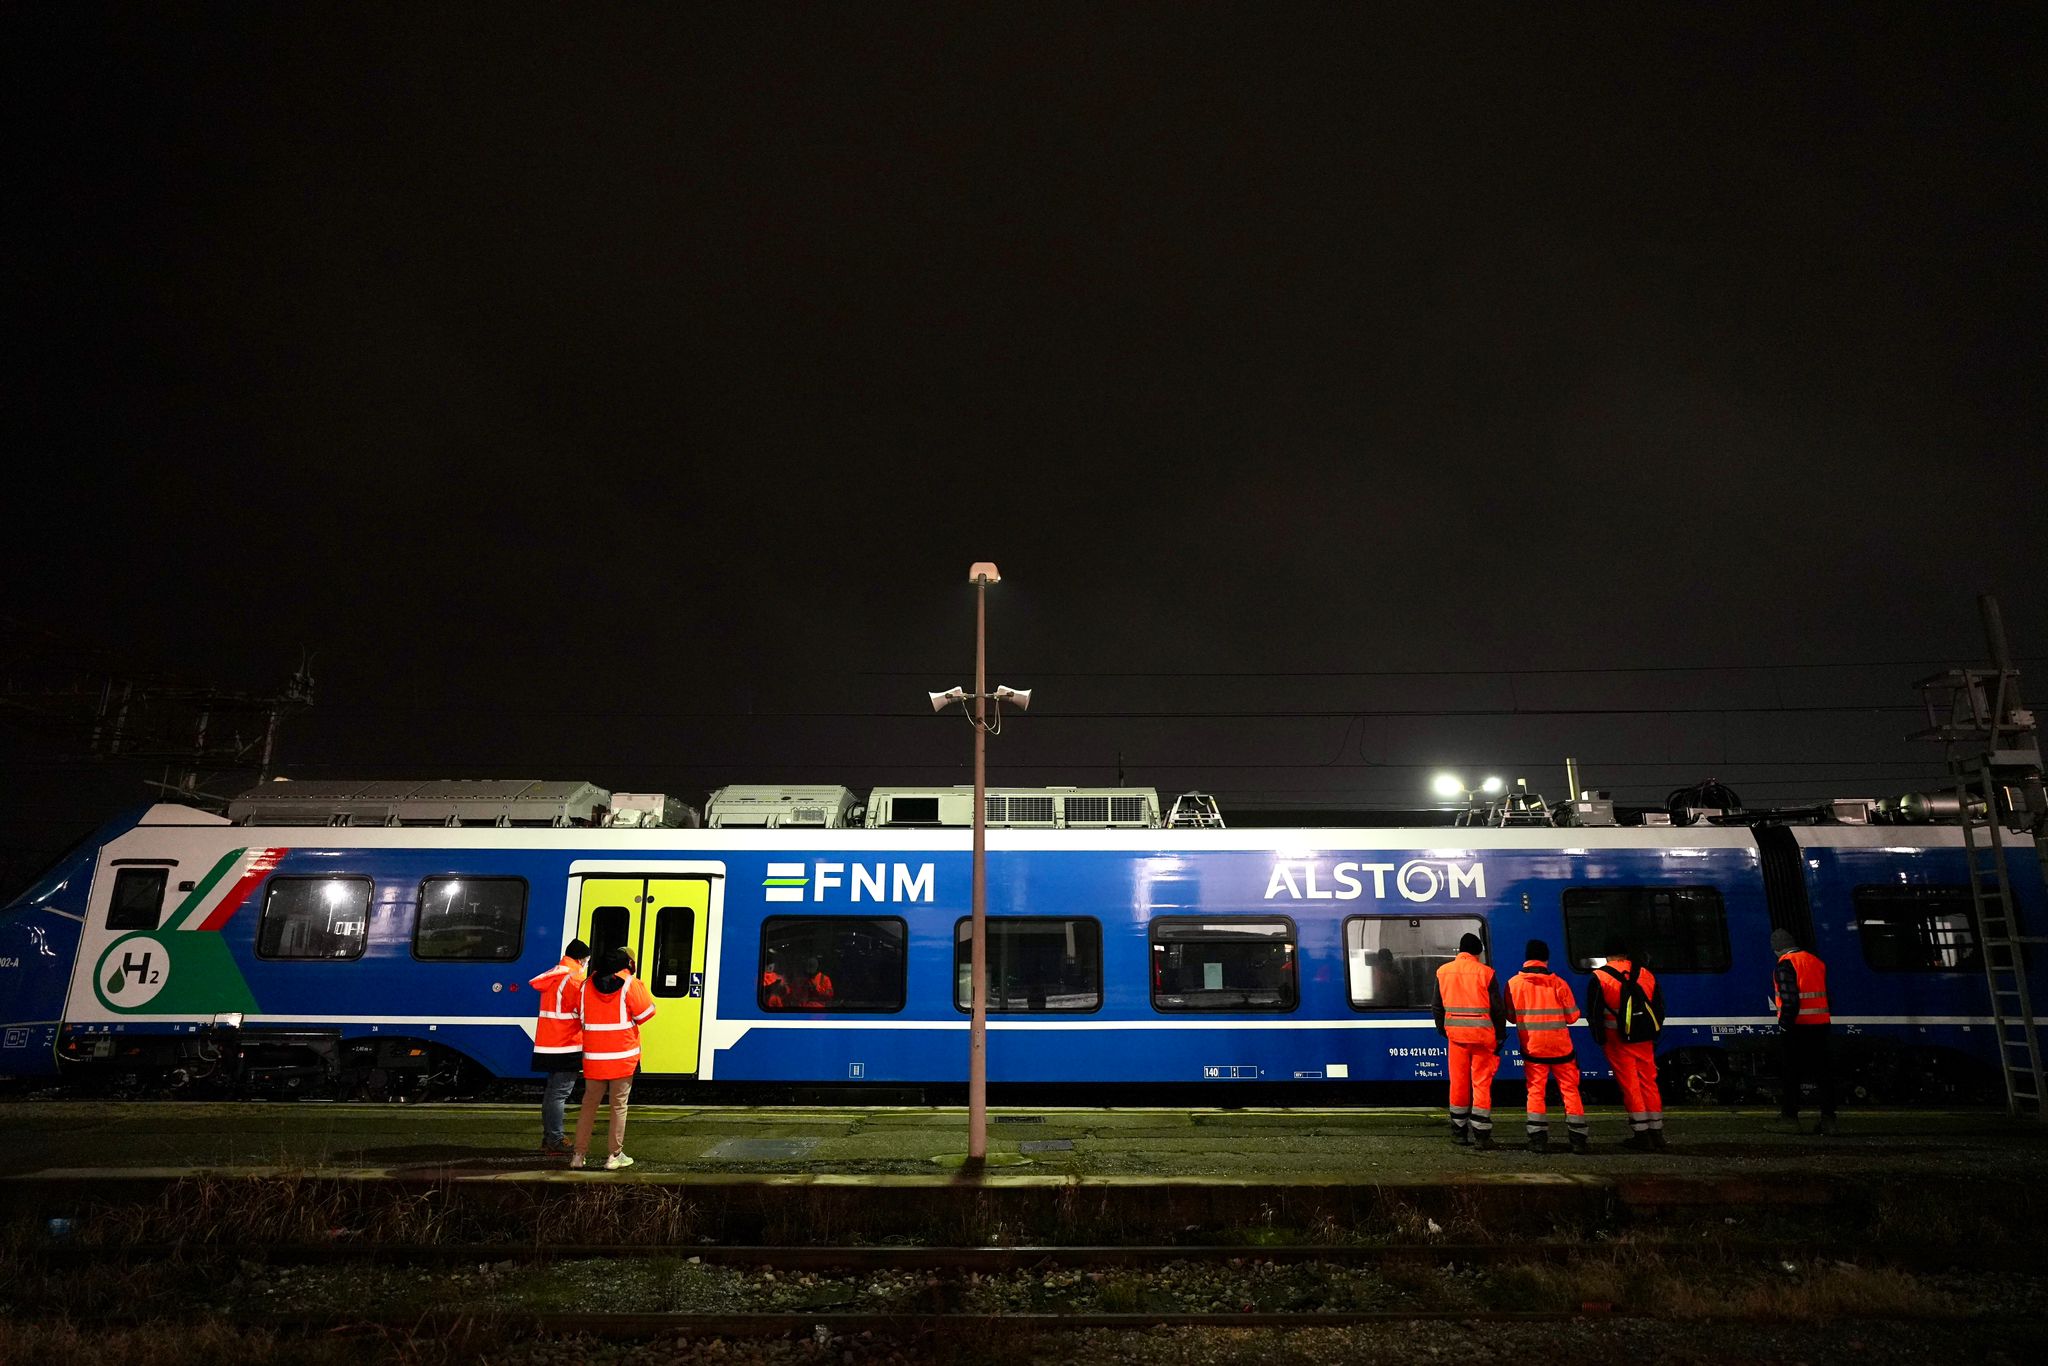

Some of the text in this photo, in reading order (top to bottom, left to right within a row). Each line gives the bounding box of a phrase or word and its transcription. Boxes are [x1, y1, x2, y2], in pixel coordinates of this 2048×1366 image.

[814, 862, 935, 902] FNM
[1264, 860, 1486, 902] ALSTOM
[0, 957, 19, 967] 02-A
[1389, 1048, 1447, 1056] 90 83 4214 021-1
[1205, 1067, 1218, 1077] 140
